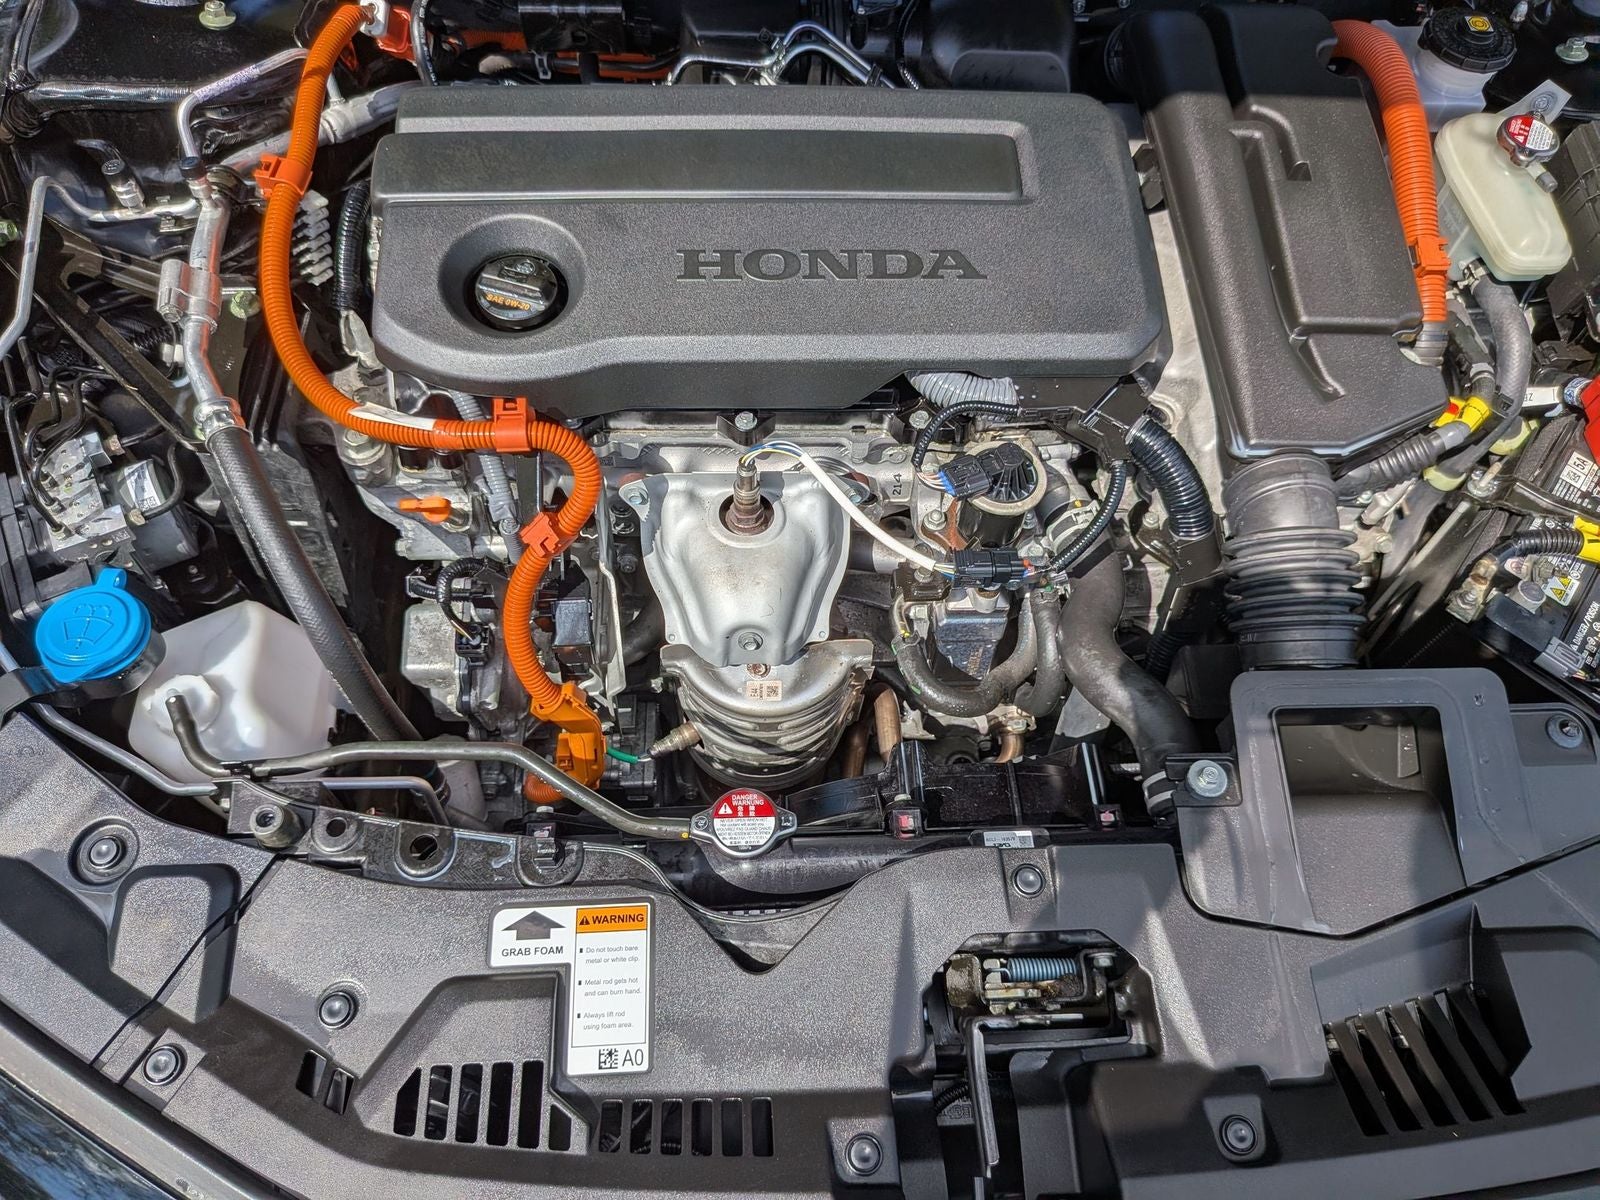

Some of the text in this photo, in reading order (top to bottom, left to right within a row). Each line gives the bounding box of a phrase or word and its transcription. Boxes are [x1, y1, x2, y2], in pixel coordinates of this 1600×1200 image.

[676, 249, 987, 281] HONDA
[486, 293, 530, 311] SAE 0W-20
[892, 472, 903, 496] 214
[592, 913, 645, 925] WARNING
[501, 945, 564, 957] GRAB FOAM
[614, 978, 627, 986] gets
[583, 1012, 605, 1020] Always
[622, 1048, 644, 1067] A0
